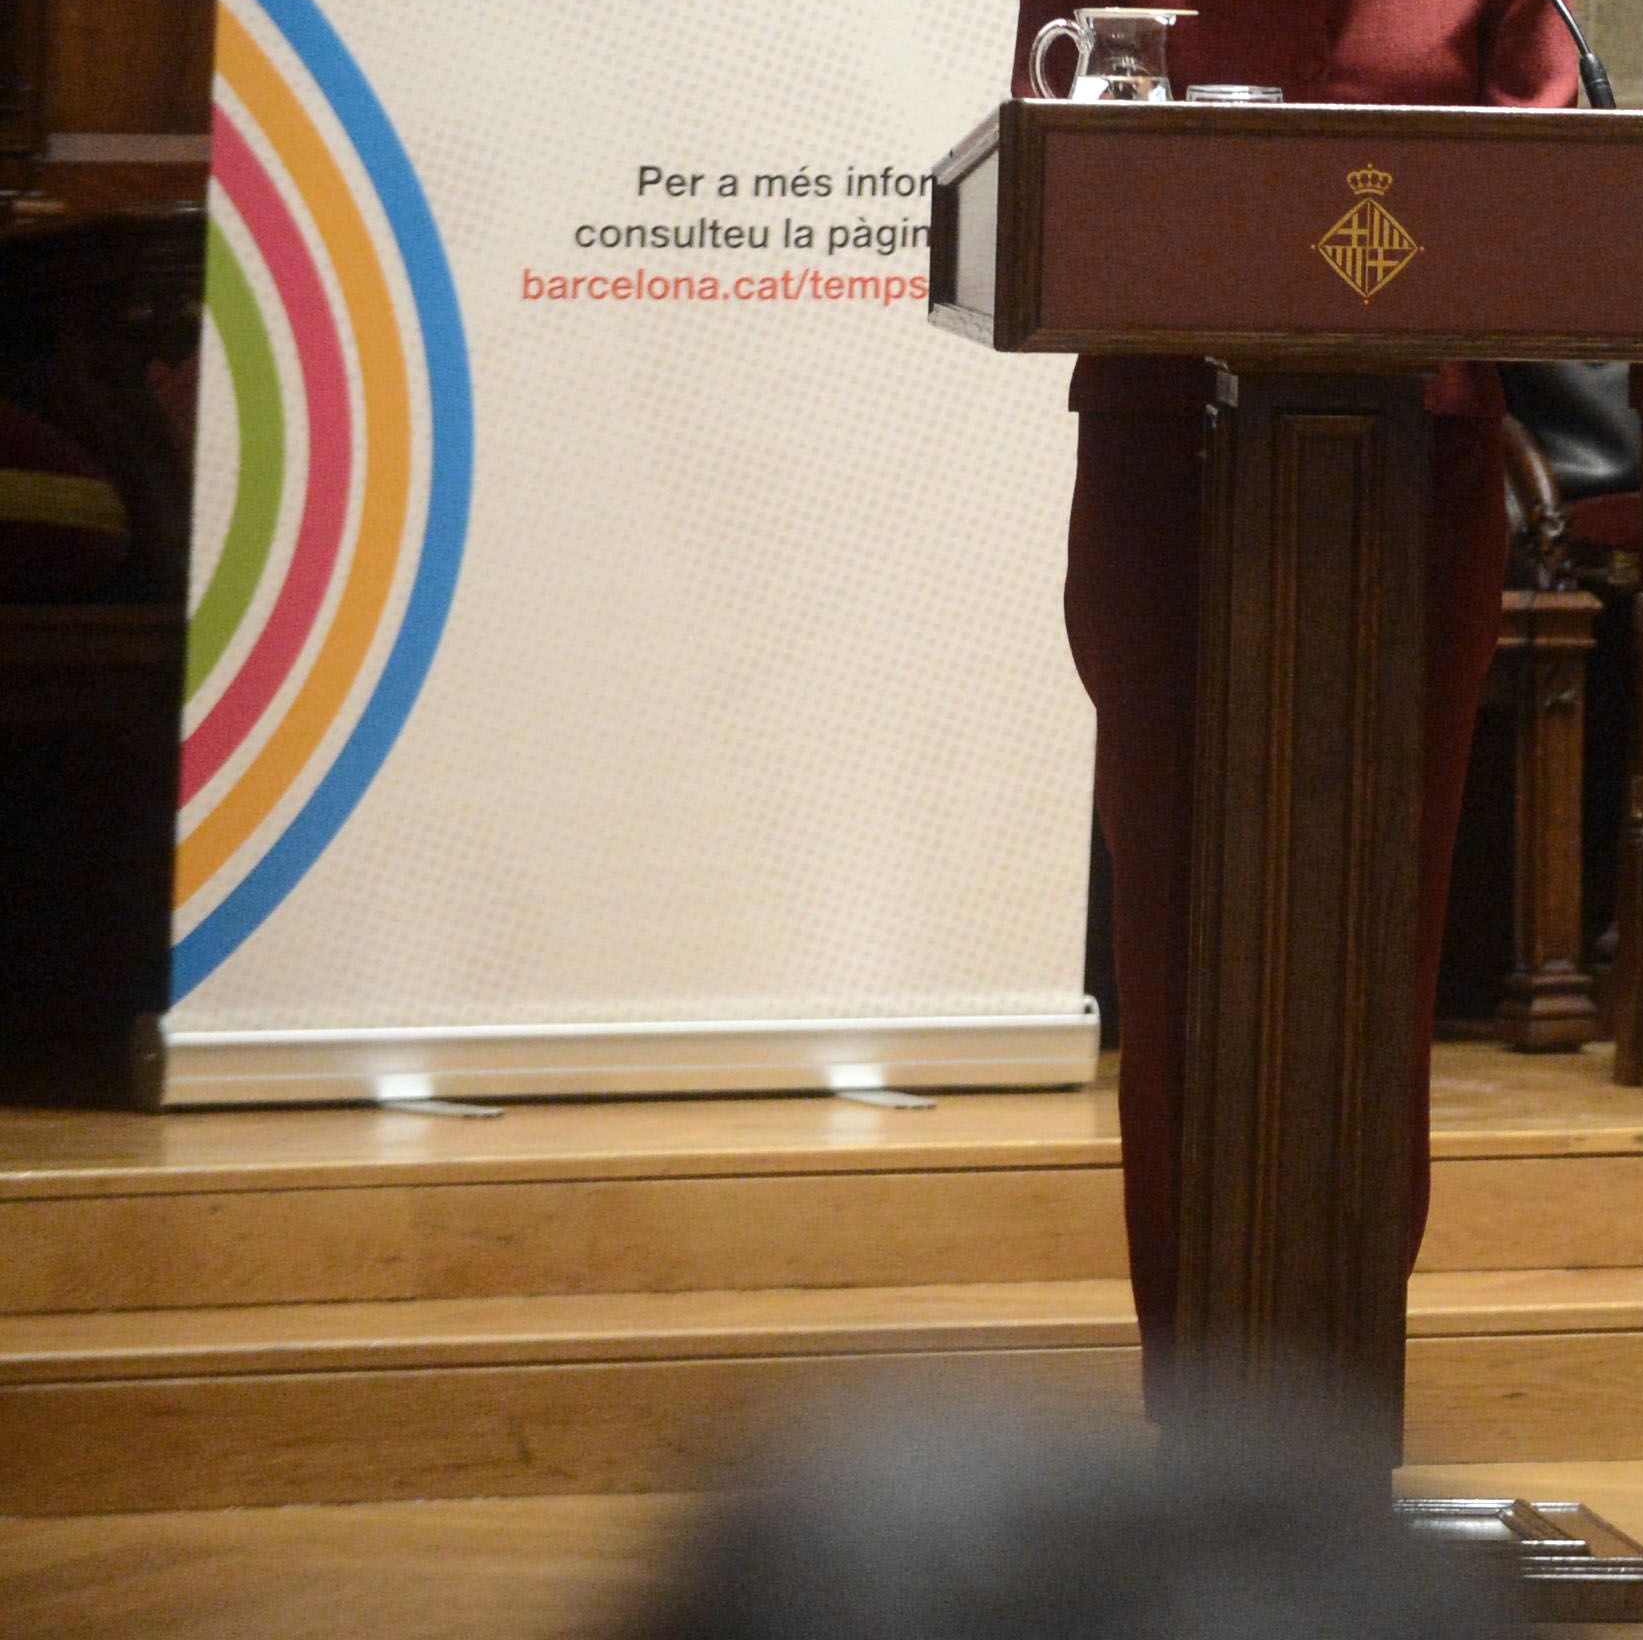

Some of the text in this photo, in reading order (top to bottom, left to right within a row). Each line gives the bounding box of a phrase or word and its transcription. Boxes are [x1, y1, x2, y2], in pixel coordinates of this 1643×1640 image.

[638, 166, 704, 197] Per
[718, 174, 738, 197] a
[754, 164, 832, 197] més
[575, 218, 769, 249] consulteu
[784, 218, 814, 249] la
[522, 267, 930, 307] barcelona.cat/temps
